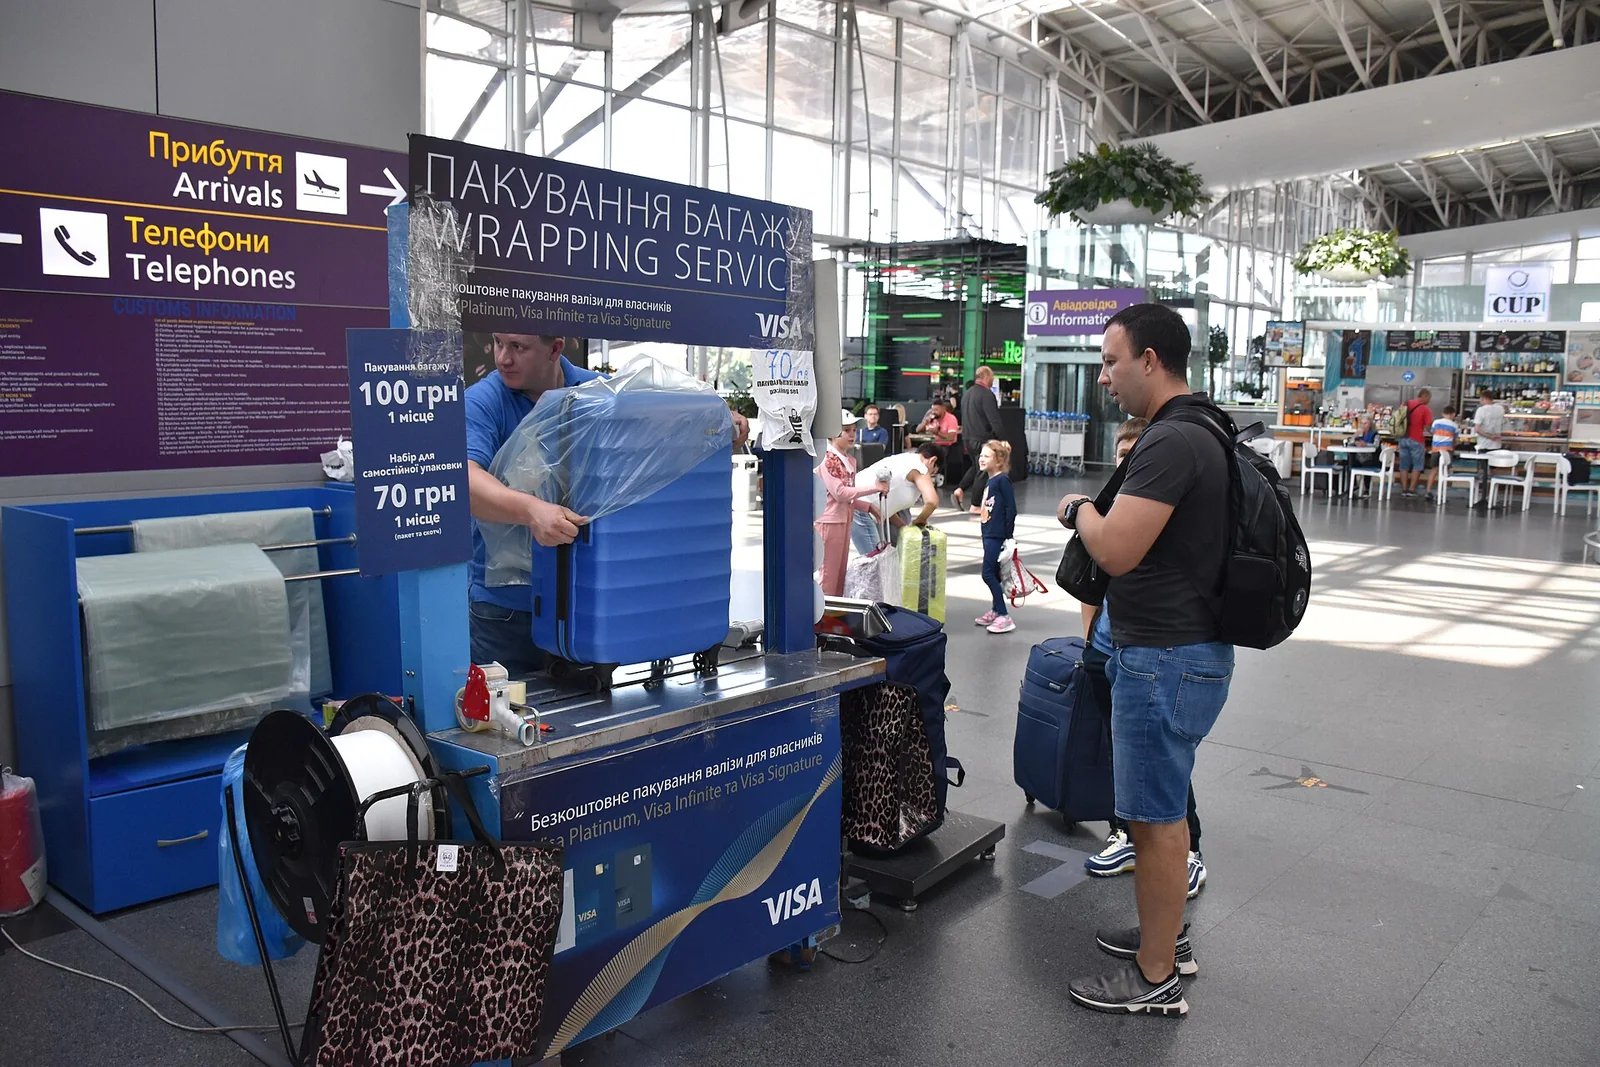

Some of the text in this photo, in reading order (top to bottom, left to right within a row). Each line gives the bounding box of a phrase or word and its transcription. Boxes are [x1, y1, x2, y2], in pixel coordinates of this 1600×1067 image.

[149, 130, 283, 175] Прибуття
[173, 172, 283, 209] Arrivals
[426, 151, 803, 253] ПАКУВАННЯ БАГАЖУ
[125, 215, 270, 256] Телефони
[427, 206, 659, 277] WRAPPING
[126, 253, 295, 290] Telephones
[113, 297, 296, 321] CUSTOMS INFORMATION
[511, 287, 569, 304] пакування
[571, 292, 604, 308] валізи
[605, 297, 623, 310] для
[625, 299, 672, 313] власників
[1053, 299, 1117, 312] Авіадовідка
[1493, 296, 1541, 314] CUP
[460, 299, 518, 320] Platinum,
[520, 305, 543, 320] Visa
[546, 306, 585, 323] Infinite
[600, 312, 621, 326] Visa
[623, 316, 672, 331] Signature
[755, 312, 803, 339] VISA
[1050, 313, 1113, 326] Informatio
[765, 350, 792, 379] 70
[1004, 340, 1024, 363] He
[365, 362, 450, 372] Пакування багажу
[359, 380, 458, 409] 100 грн
[388, 410, 434, 424] 1 місце
[363, 462, 462, 478] самостійної упаковки
[390, 452, 435, 464] Набір для
[374, 483, 456, 511] 70 грн
[394, 513, 440, 527] 1 місце
[395, 531, 414, 541] (пакет
[423, 528, 442, 538] скотч)
[530, 731, 823, 832] Безкоштовне пакування валізи для власників
[569, 812, 641, 846] Platinum,
[643, 793, 672, 820] Visa
[675, 784, 723, 811] Infinite
[740, 768, 765, 787] Visa
[767, 753, 823, 782] Signature
[617, 897, 631, 908] VISA
[761, 877, 823, 926] VISA
[577, 909, 597, 922] VISA
